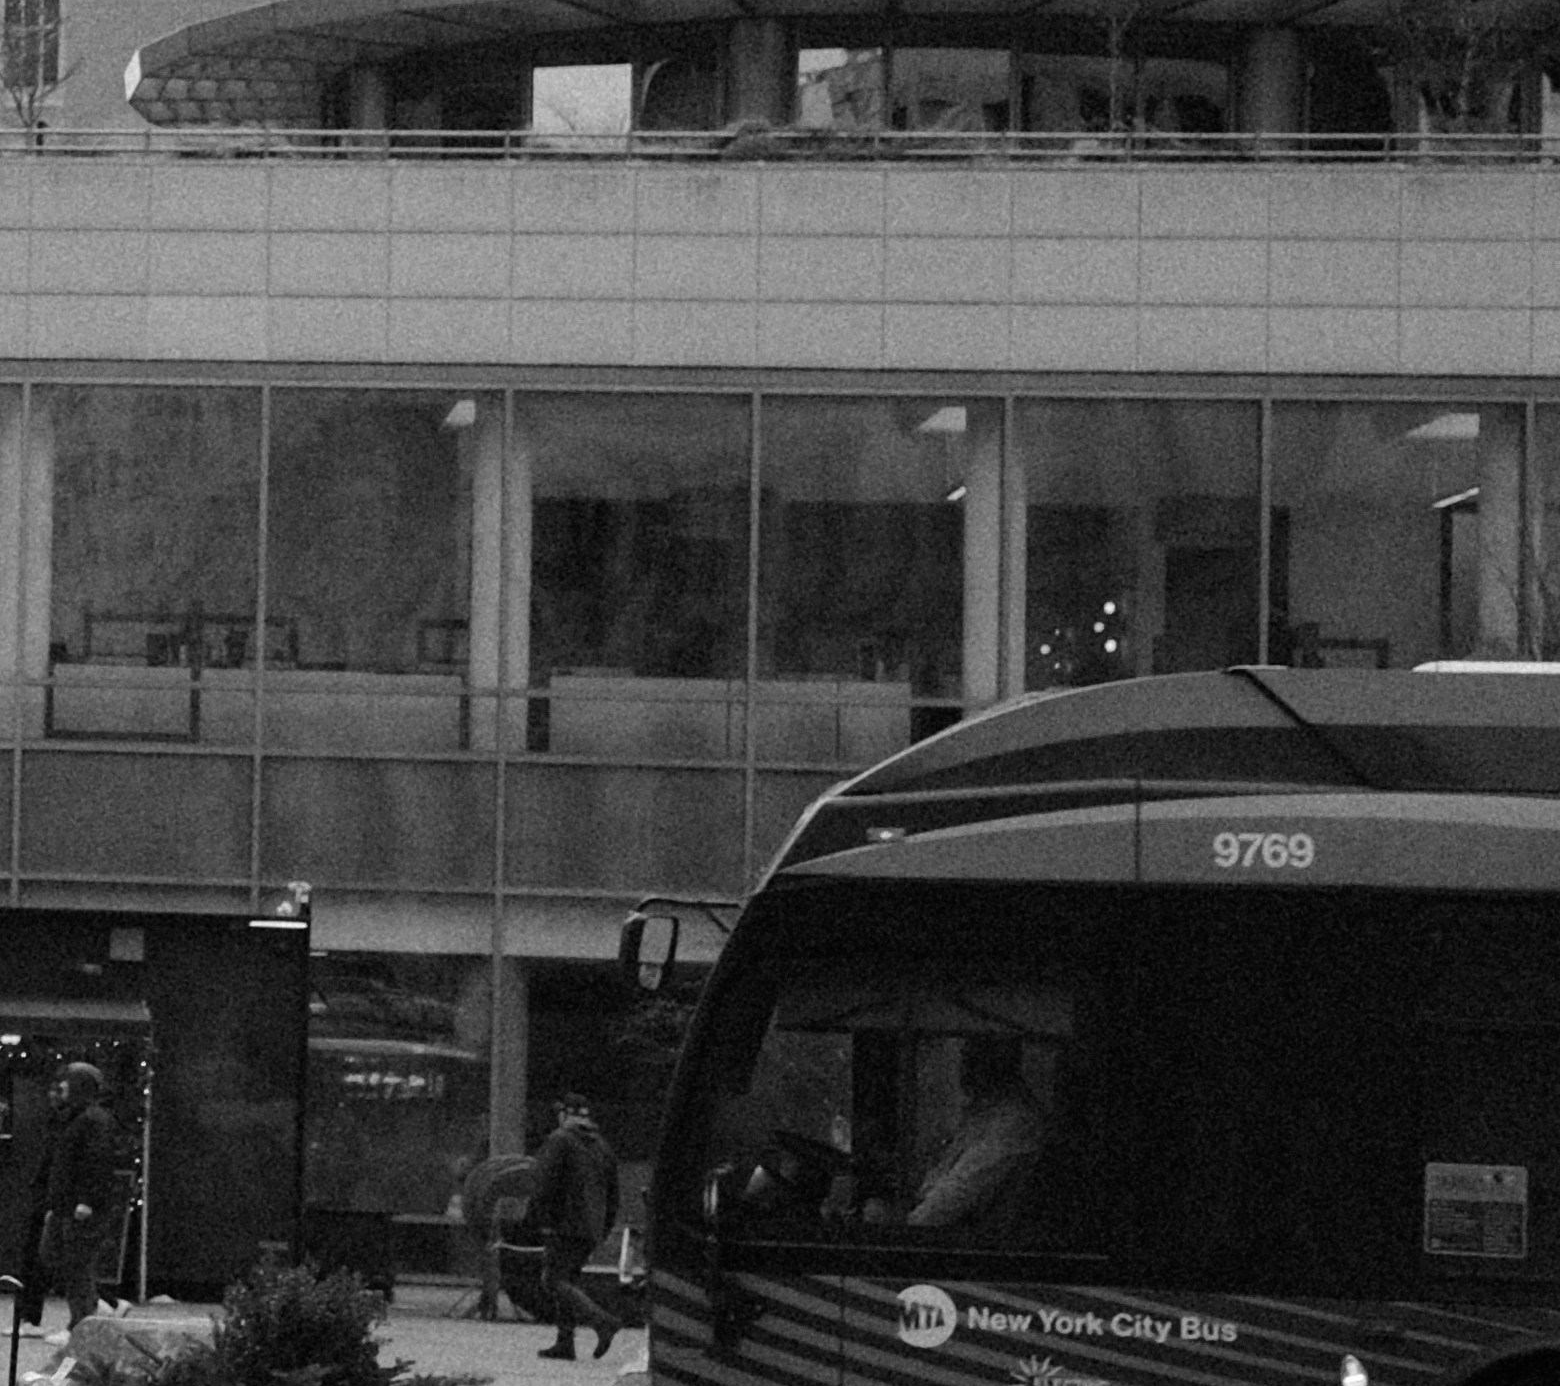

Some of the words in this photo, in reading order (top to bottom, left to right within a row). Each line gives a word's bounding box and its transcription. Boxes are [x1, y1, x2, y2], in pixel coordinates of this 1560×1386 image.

[1213, 832, 1315, 868] 9769
[898, 1300, 945, 1331] MTA
[967, 1306, 1032, 1332] New
[1037, 1309, 1104, 1336] York
[1110, 1312, 1171, 1343] City
[1180, 1316, 1238, 1342] Bus
